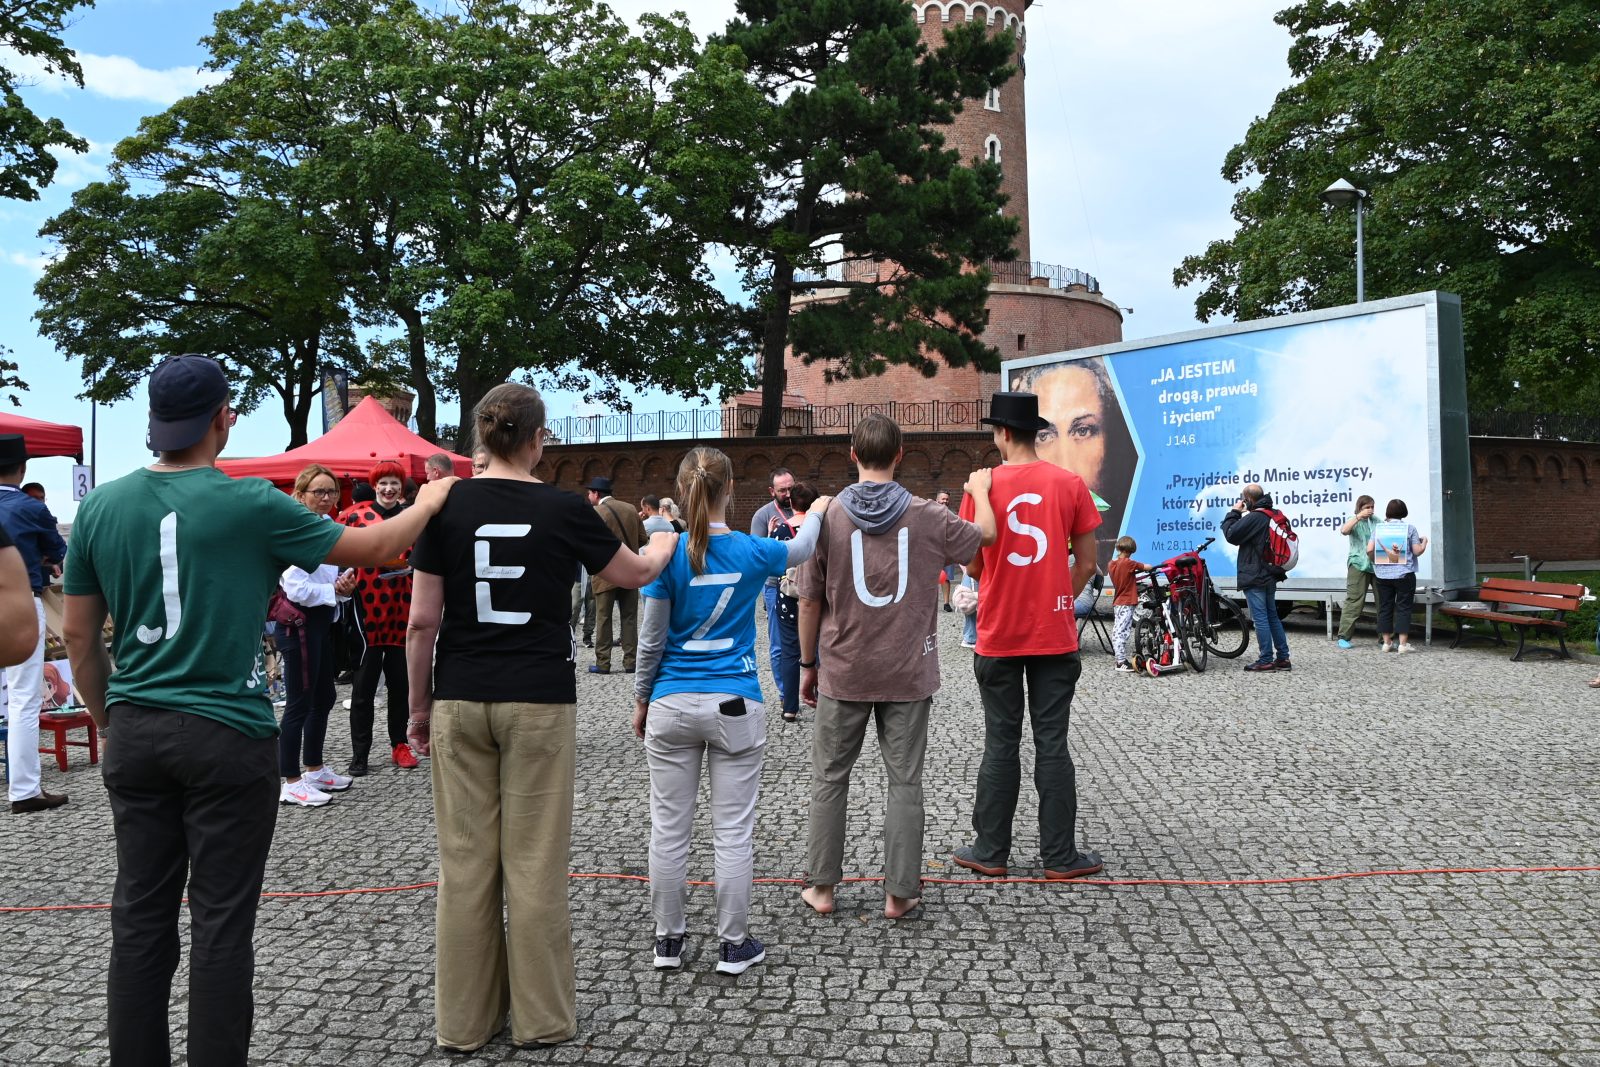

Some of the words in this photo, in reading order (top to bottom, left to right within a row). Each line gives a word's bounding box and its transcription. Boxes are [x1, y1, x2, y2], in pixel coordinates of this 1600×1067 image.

[1177, 359, 1235, 380] JESTEM
[1159, 390, 1203, 404] drogą,
[1206, 380, 1258, 402] prawdą
[1163, 411, 1167, 424] i
[1166, 436, 1172, 446] J
[1174, 434, 1196, 446] 14,6
[78, 473, 88, 498] 3
[1243, 470, 1260, 483] do
[1264, 467, 1300, 482] Mnie
[1303, 466, 1372, 482] wszyscy,
[1162, 495, 1203, 512] którzy
[1275, 491, 1279, 505] i
[1282, 487, 1352, 507] obciążeni
[1006, 492, 1048, 567] S
[1156, 517, 1216, 535] jesteście,
[1290, 512, 1347, 531] okrzepi
[1151, 541, 1165, 551] Mt
[136, 511, 182, 645] J
[474, 523, 532, 625] E
[850, 526, 909, 608] U
[682, 572, 743, 651] Z
